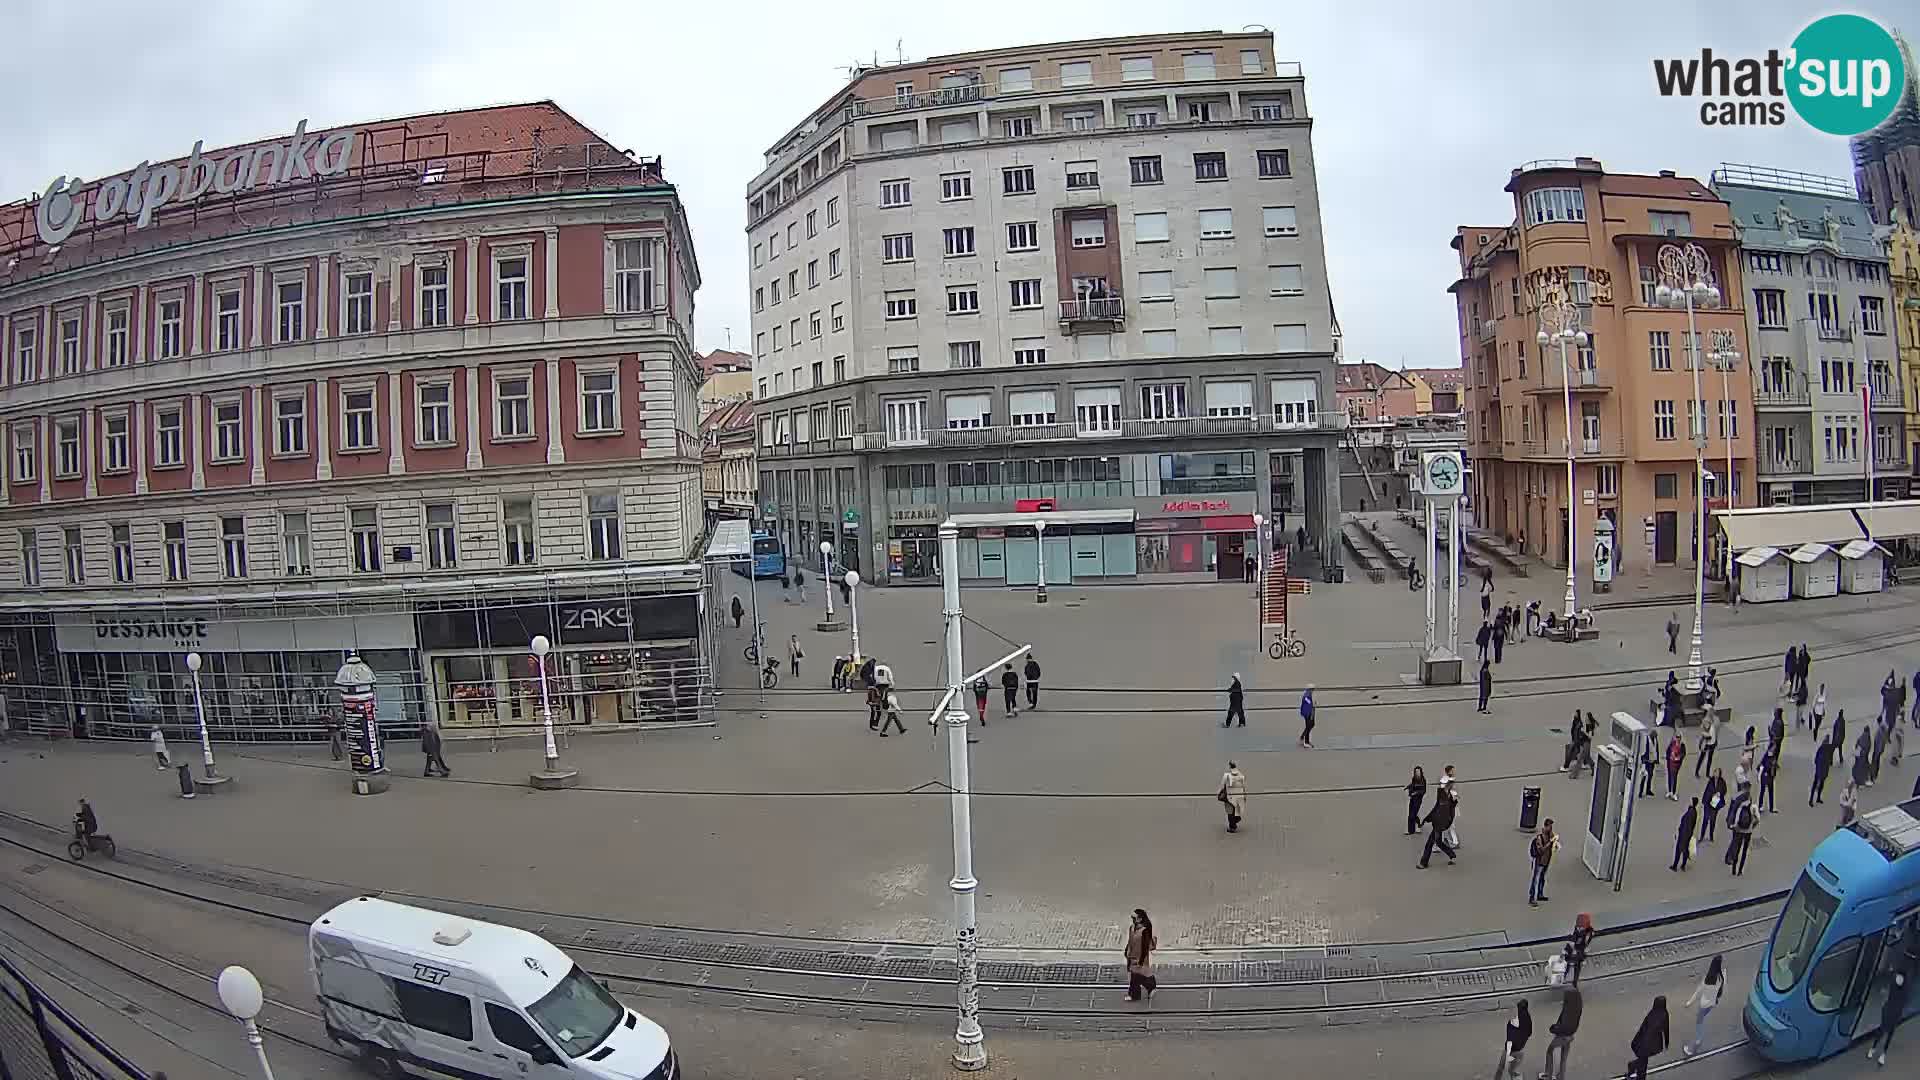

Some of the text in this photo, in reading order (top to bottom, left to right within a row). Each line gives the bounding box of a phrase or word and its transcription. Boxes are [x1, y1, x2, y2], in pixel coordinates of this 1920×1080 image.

[96, 617, 208, 638] DESSANGE
[564, 606, 633, 630] ZAKS
[413, 962, 451, 985] ZET
